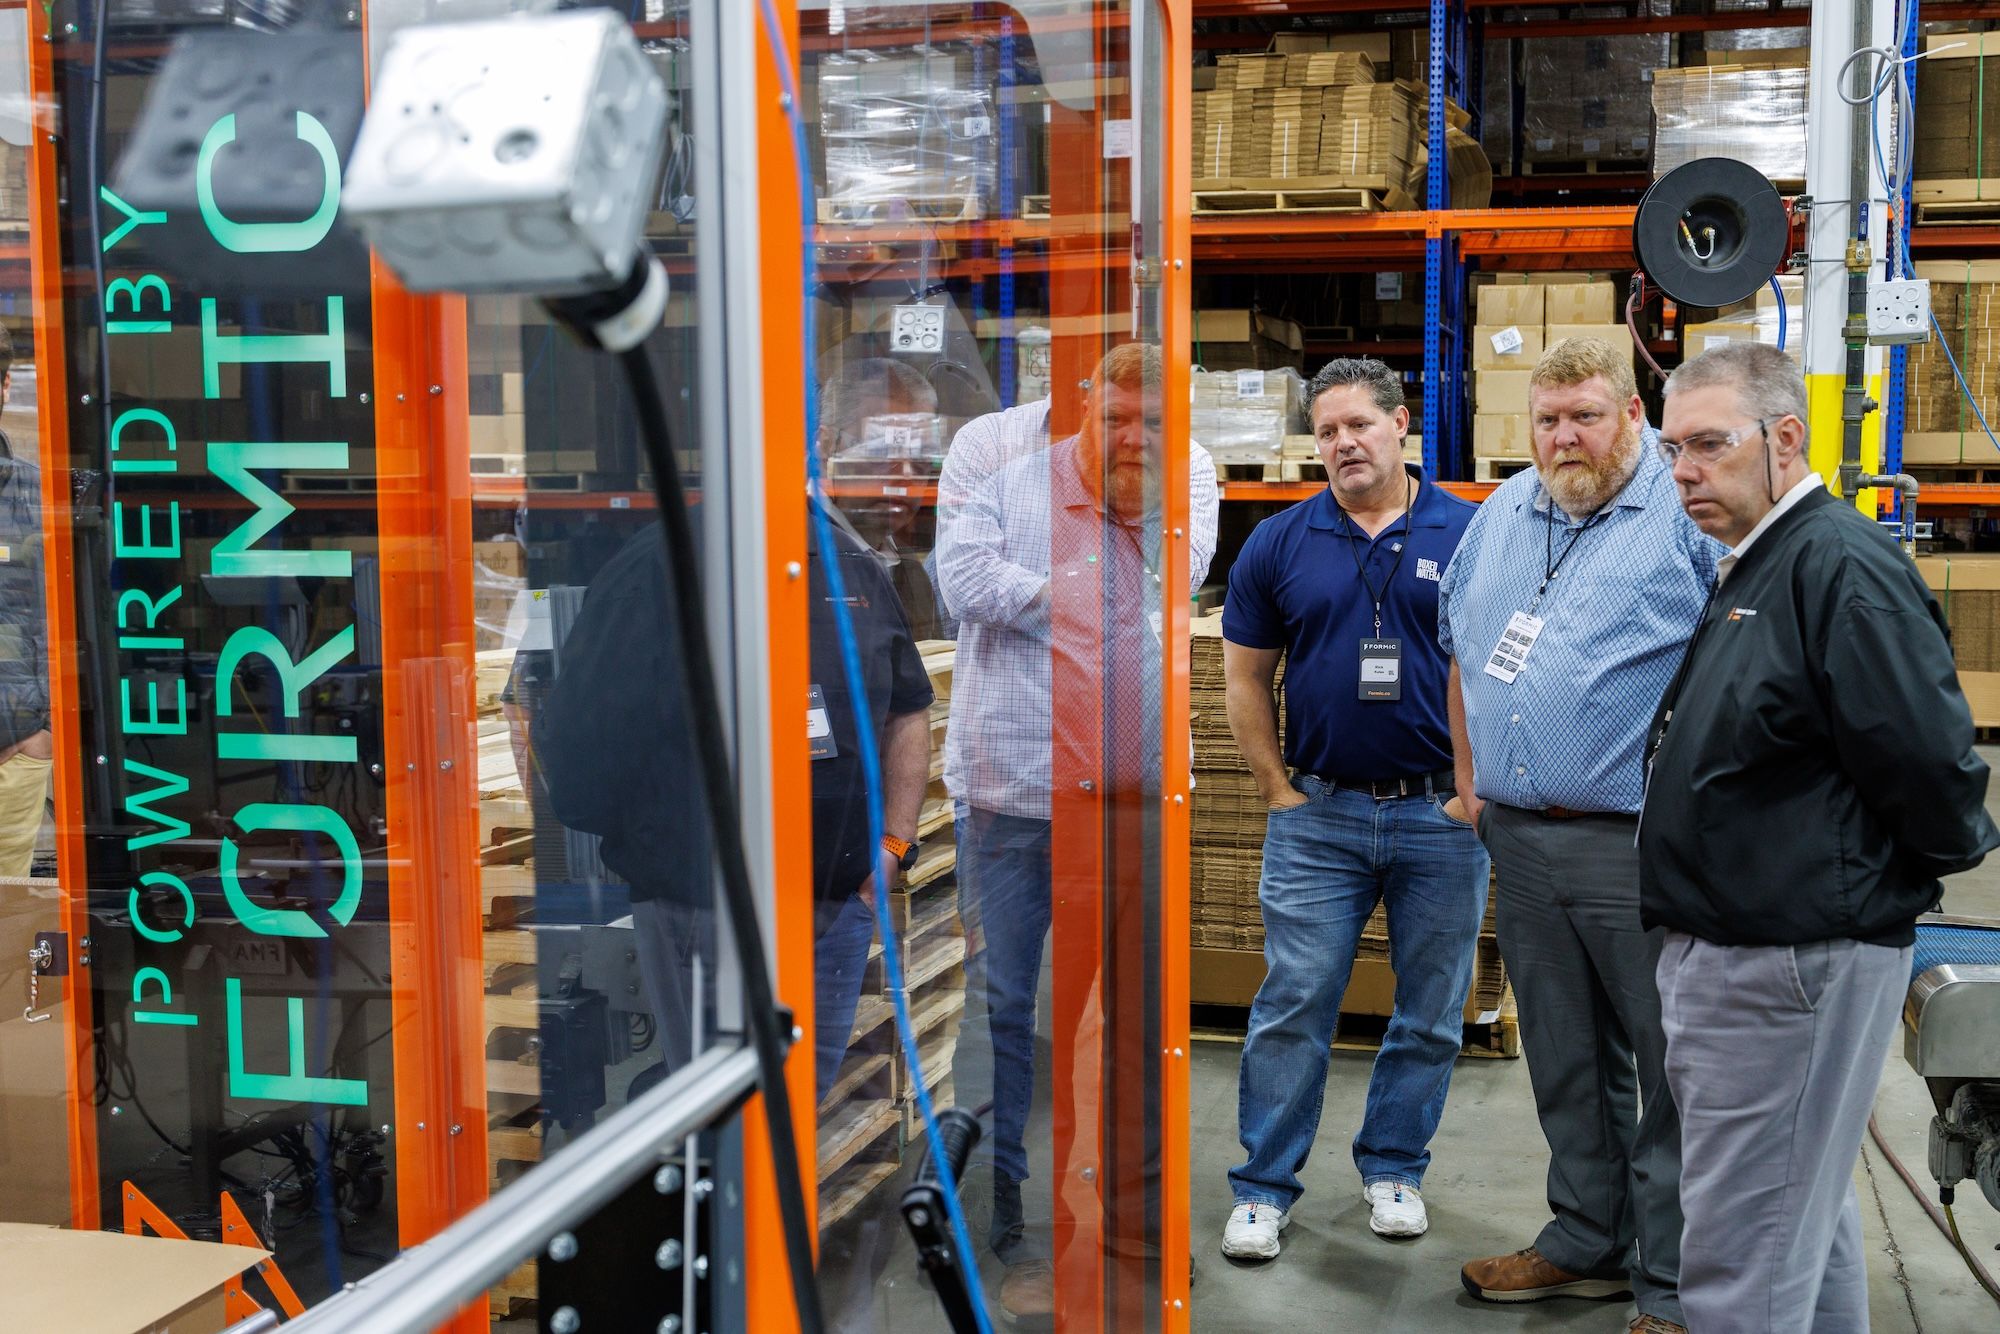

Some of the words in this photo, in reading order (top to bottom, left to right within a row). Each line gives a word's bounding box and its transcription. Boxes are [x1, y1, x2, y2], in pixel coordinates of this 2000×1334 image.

[101, 186, 172, 334] BY
[111, 407, 199, 1026] POWERED
[196, 110, 369, 1108] FORMIC
[1417, 558, 1438, 571] BOXED
